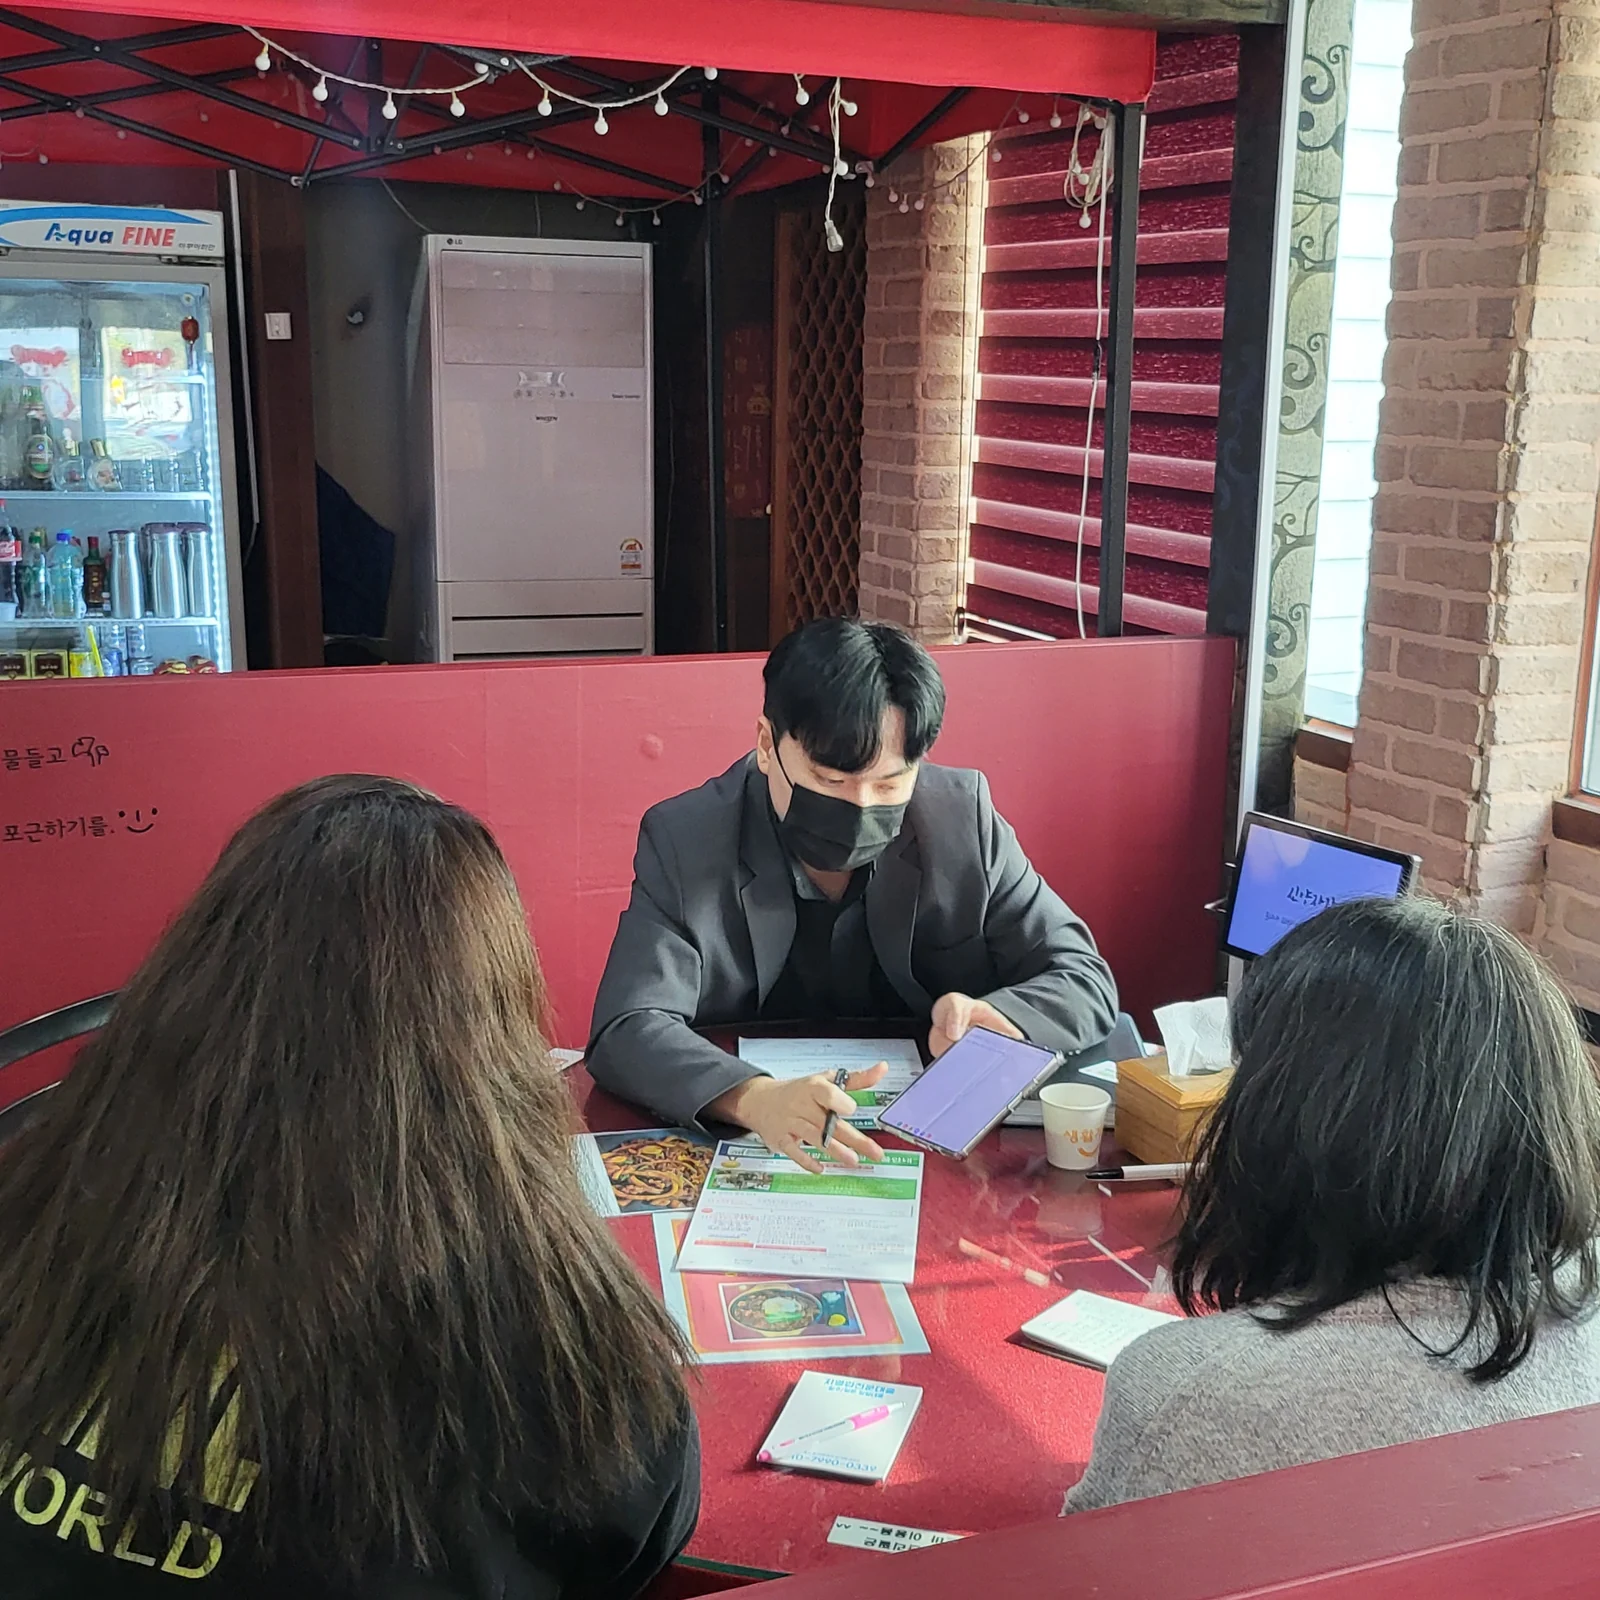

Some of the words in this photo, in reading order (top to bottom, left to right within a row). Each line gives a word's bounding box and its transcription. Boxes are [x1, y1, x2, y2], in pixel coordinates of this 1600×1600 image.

[44, 222, 114, 246] Aqua
[122, 226, 176, 247] FINE
[1, 747, 67, 771] 물들고
